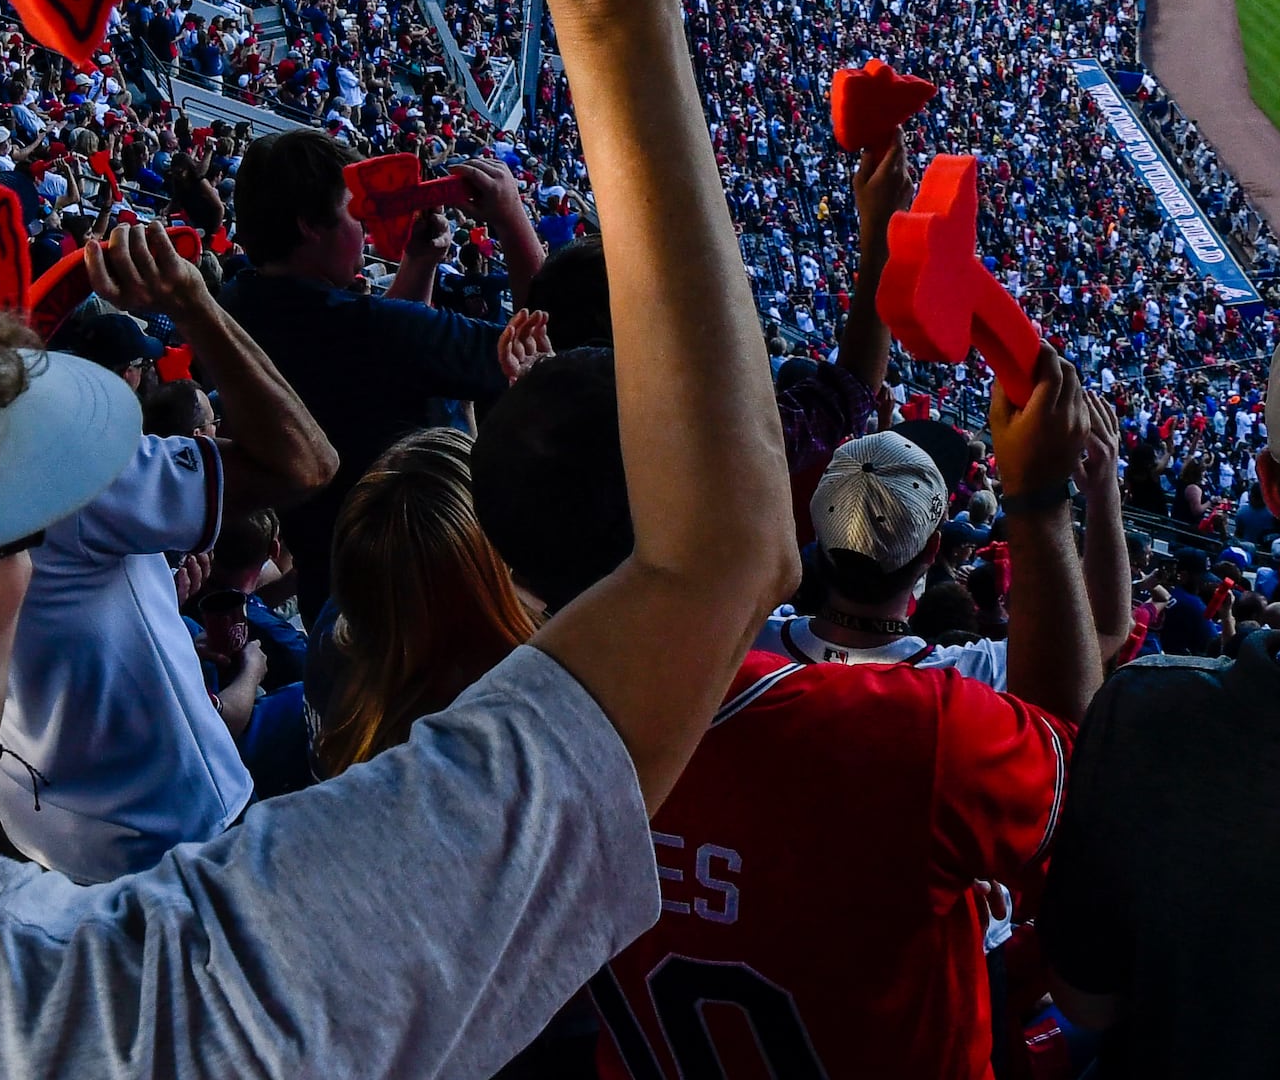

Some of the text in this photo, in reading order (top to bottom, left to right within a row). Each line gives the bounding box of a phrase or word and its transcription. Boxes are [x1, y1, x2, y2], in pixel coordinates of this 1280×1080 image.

[1087, 83, 1225, 263] WELCOME TO TURNER FIELD
